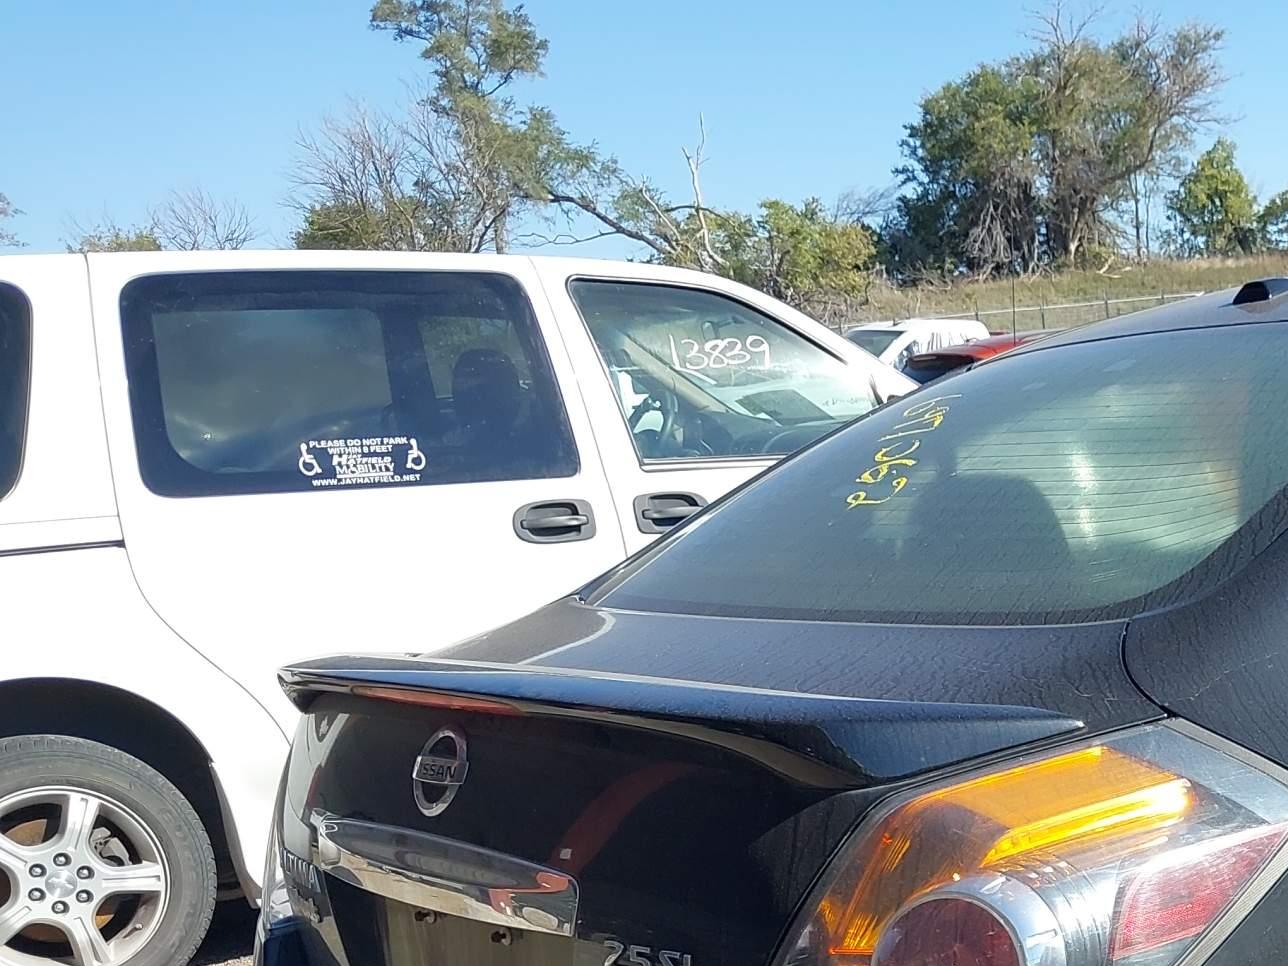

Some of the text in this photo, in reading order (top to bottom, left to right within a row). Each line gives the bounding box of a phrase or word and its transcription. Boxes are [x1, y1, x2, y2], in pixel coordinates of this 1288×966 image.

[309, 437, 408, 448] PLEASE DO NOT PARK
[327, 446, 361, 455] WITHIN
[370, 444, 392, 453] FEET
[331, 454, 392, 466] HATFIELD
[312, 474, 421, 486] WWW.JAYHATFIELD.NET
